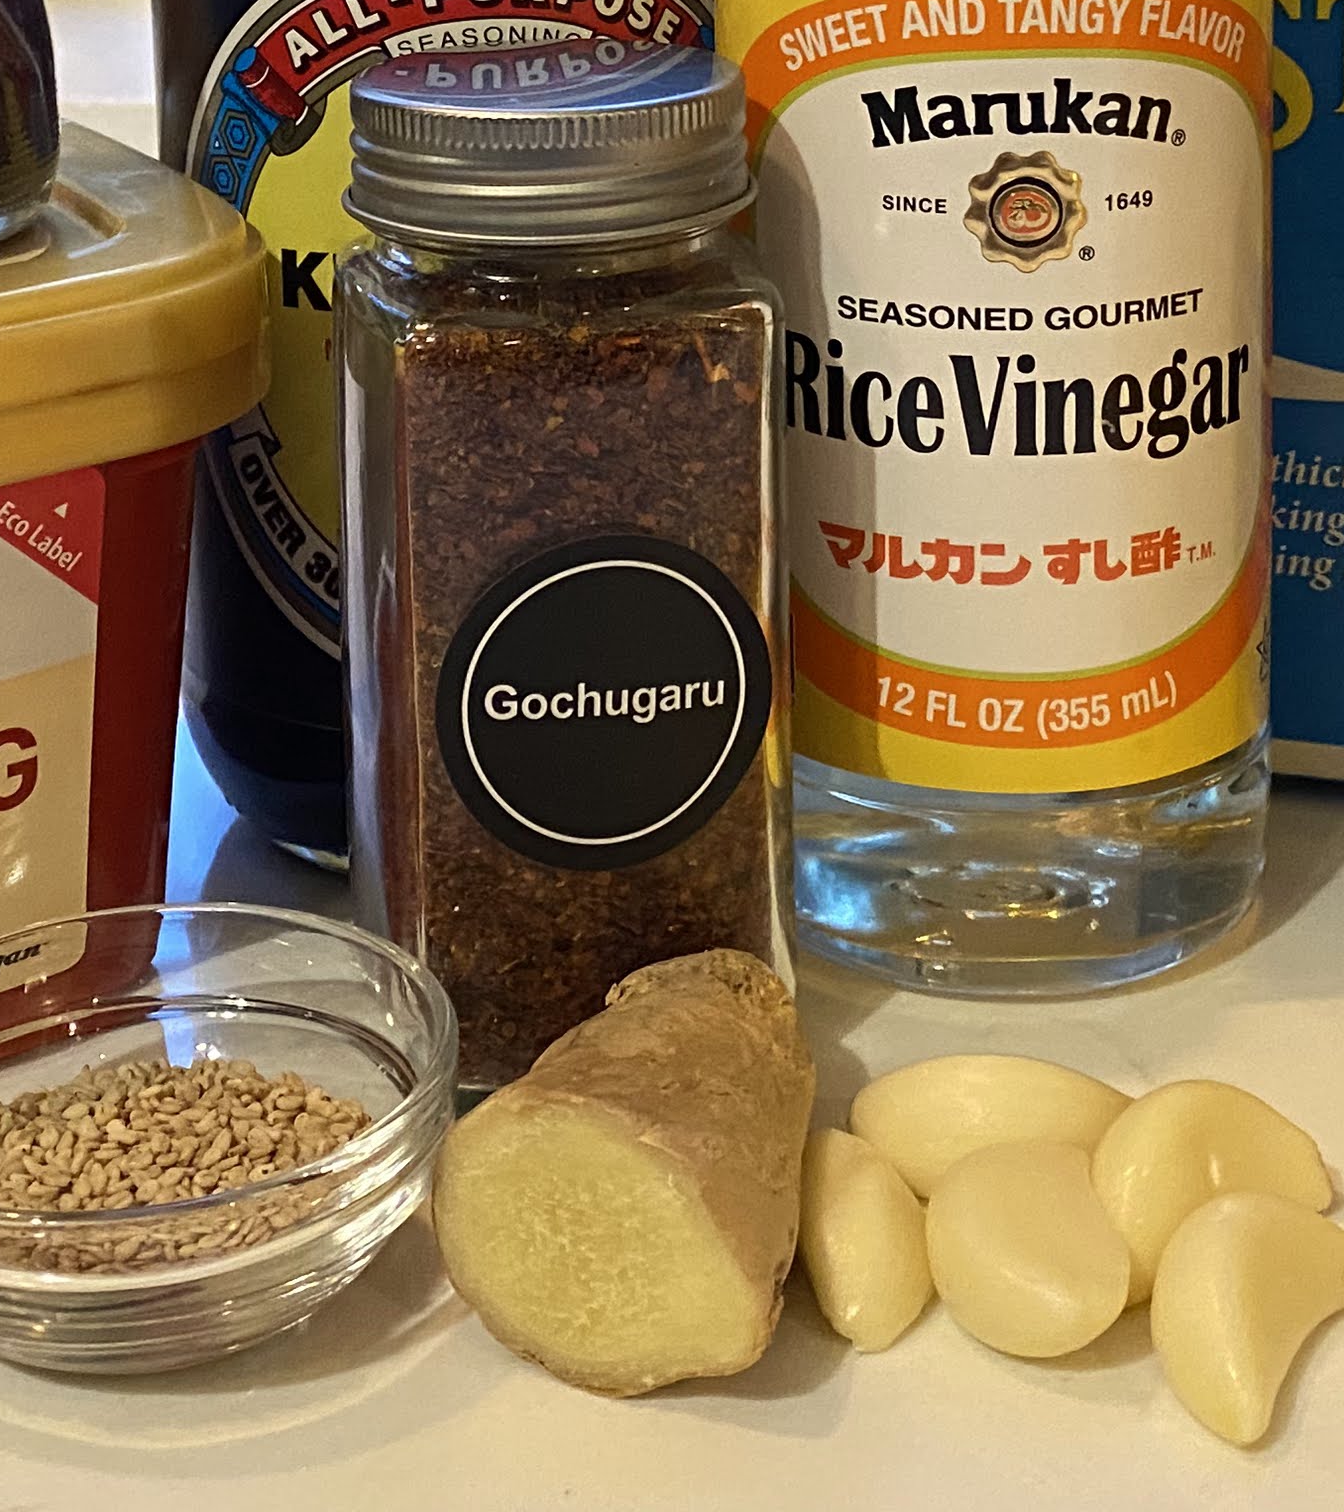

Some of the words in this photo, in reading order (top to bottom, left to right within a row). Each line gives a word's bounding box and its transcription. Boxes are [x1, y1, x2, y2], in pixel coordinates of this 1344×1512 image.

[779, 5, 887, 72] SWEET
[882, 194, 947, 214] SINCE
[1104, 191, 1154, 211] 1649
[837, 295, 1034, 332] SEASONED
[1045, 290, 1204, 329] GOURMET
[786, 329, 945, 453] Rice
[948, 337, 1250, 460] Vinegar
[240, 453, 306, 558] OVER
[27, 524, 83, 572] Label
[818, 520, 1031, 585] マルカン
[1043, 527, 1181, 585] すし酢
[1275, 545, 1336, 590] ing
[484, 680, 725, 724] Gochugaru
[878, 677, 916, 715] 12
[926, 689, 966, 728] FL
[978, 698, 1024, 733] OZ
[1037, 693, 1111, 740] (355
[1122, 670, 1177, 720] mL)
